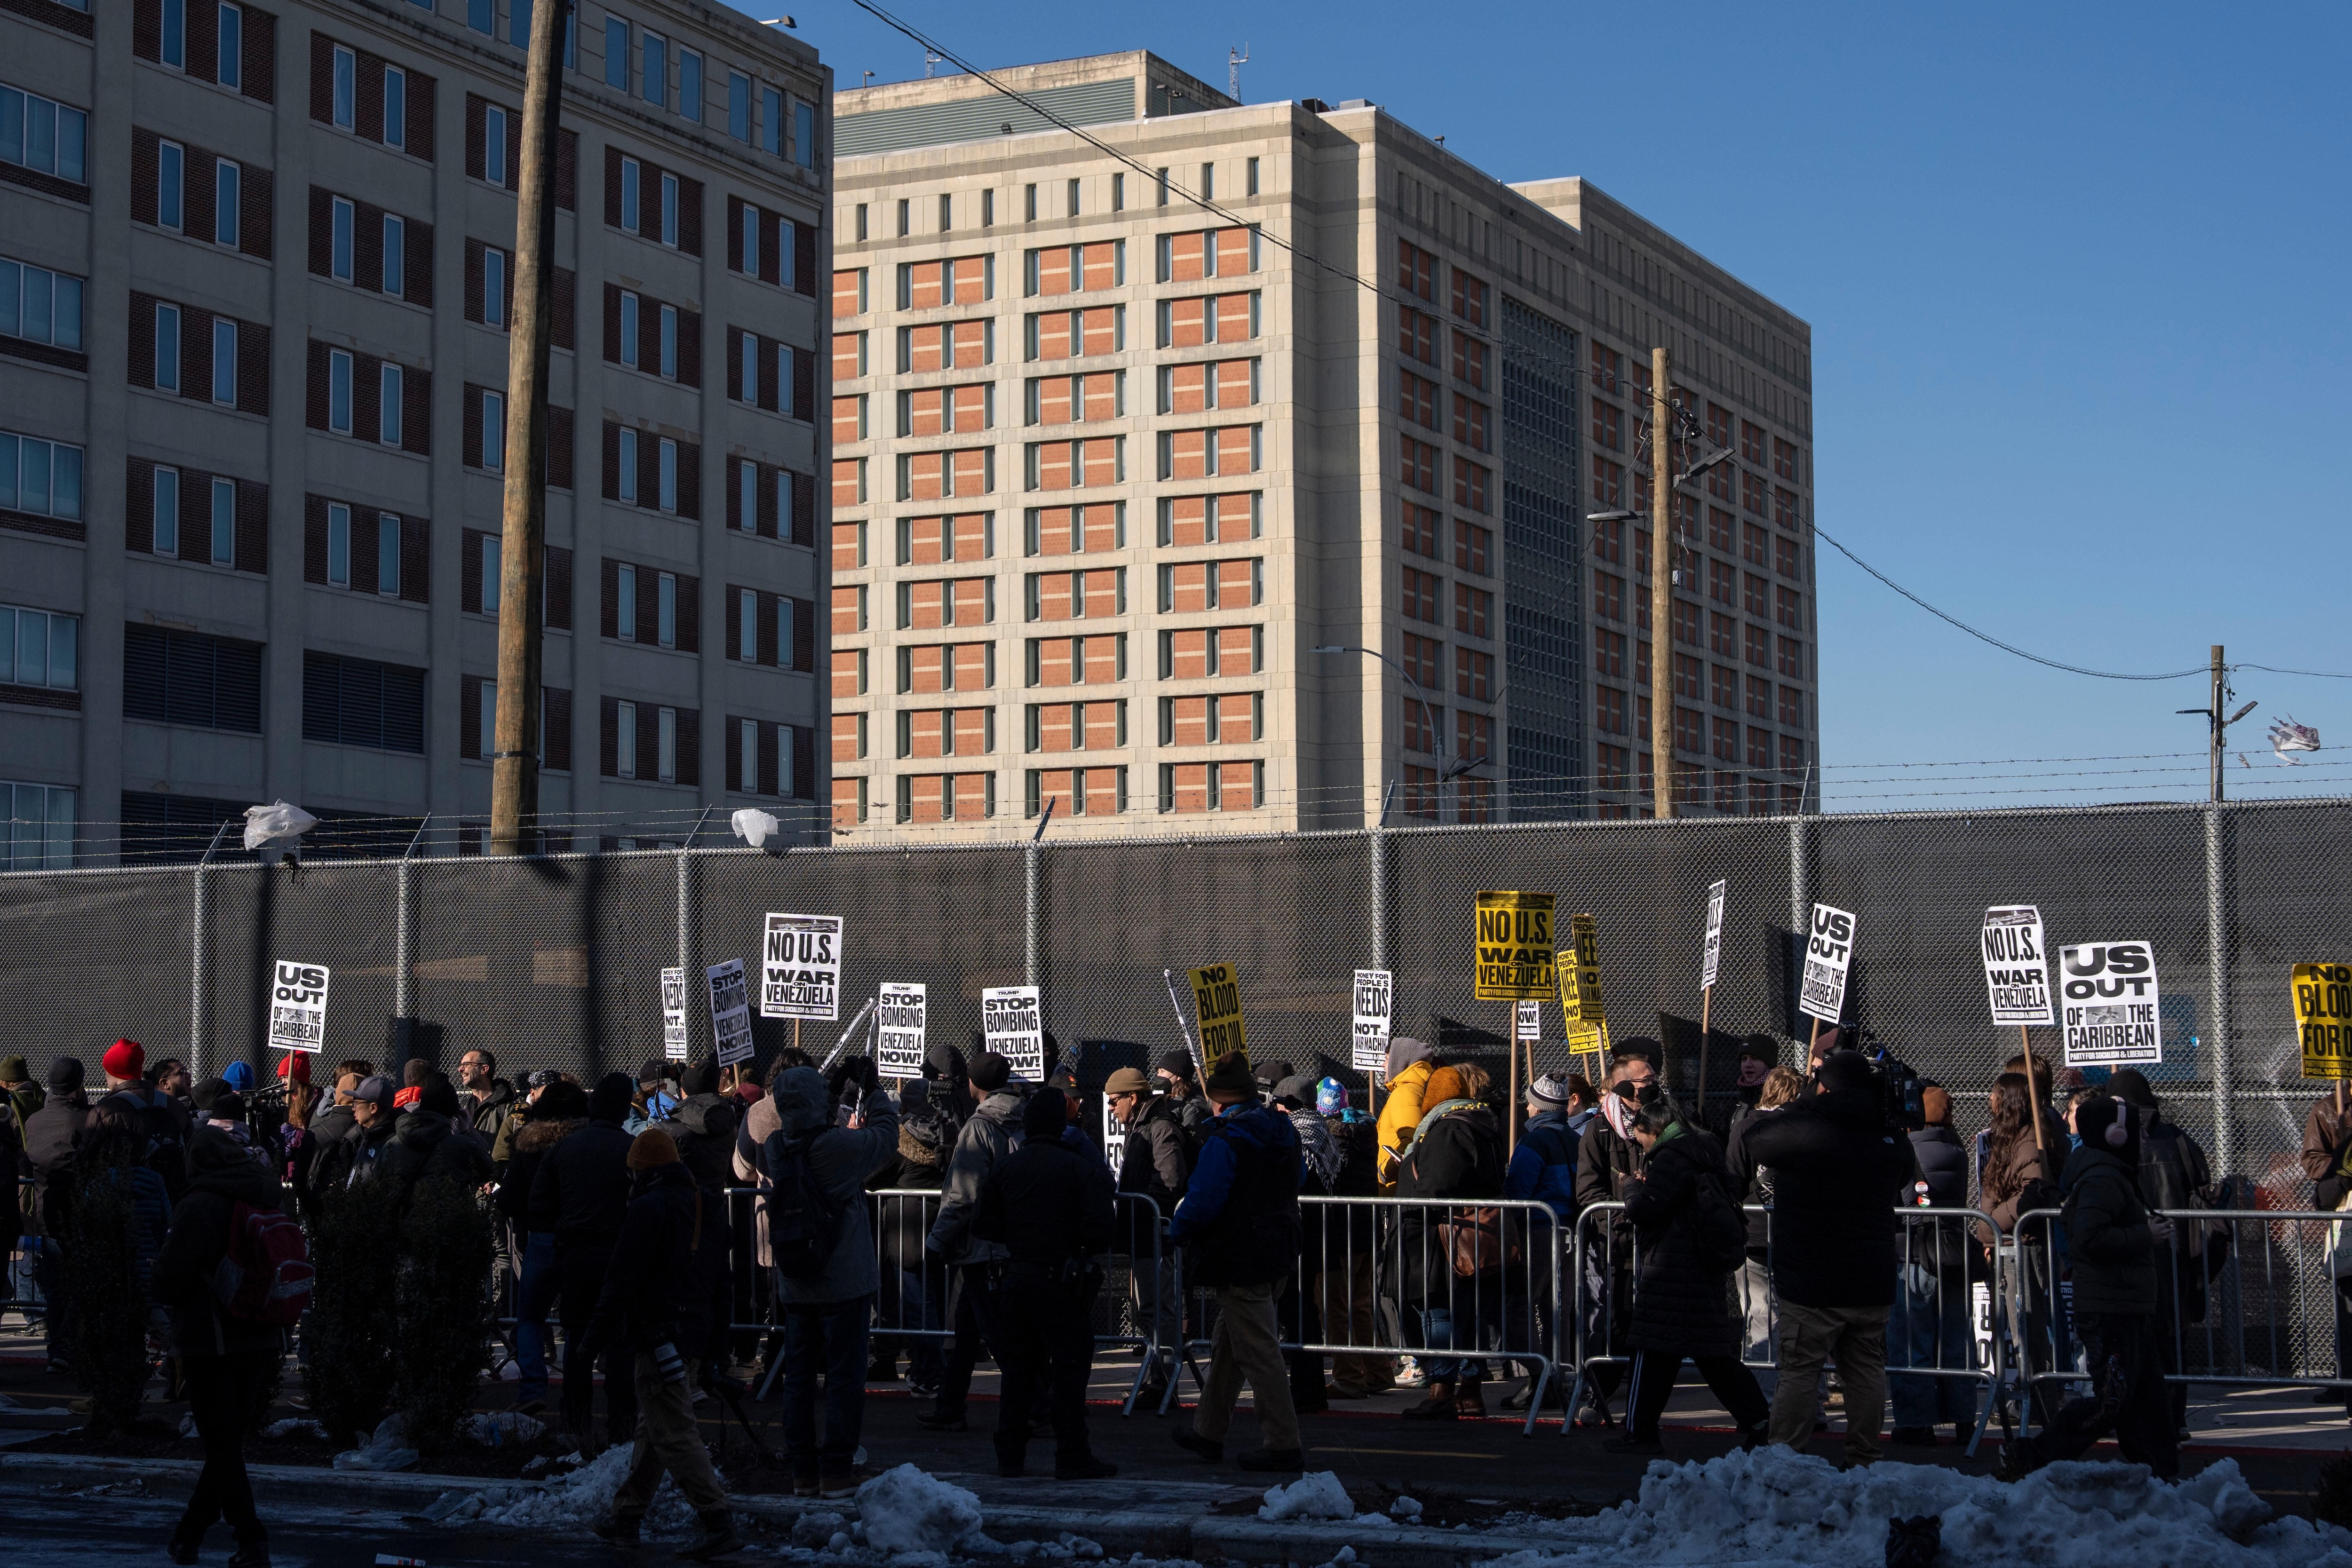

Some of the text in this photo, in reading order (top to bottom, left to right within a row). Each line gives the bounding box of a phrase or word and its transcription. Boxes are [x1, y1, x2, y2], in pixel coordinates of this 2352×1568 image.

[1479, 910, 1552, 944] NO U.S.
[1814, 908, 1851, 942] US
[768, 932, 836, 964] NO U.S.
[1574, 932, 1599, 967] NEE
[1810, 936, 1848, 962] OUT
[1984, 927, 2041, 961] NO U.S.
[1479, 947, 1551, 965] WAR
[2064, 945, 2149, 976] US
[278, 965, 325, 989] US
[712, 970, 743, 990] STOP
[767, 968, 835, 986] WAR
[1200, 966, 1227, 985] NO
[1479, 965, 1552, 987] VENEZUELA
[1806, 959, 1844, 987] OF THE
[1989, 969, 2043, 985] WAR
[2310, 966, 2351, 983] NO
[276, 987, 324, 1004] OUT
[766, 984, 834, 1006] VENEZUELA
[1561, 968, 1578, 1002] NEE
[1803, 977, 1841, 1008] CARIBBEAN
[2066, 977, 2152, 999] OUT
[714, 983, 746, 1014] BOMBING
[882, 993, 924, 1006] STOP
[985, 997, 1036, 1011] STOP
[1197, 982, 1239, 1022] BLOOD
[1356, 986, 1388, 1018] NEEDS
[1992, 987, 2047, 1008] VENEZUELA
[2297, 983, 2352, 1019] BLOO
[274, 1006, 321, 1024] OF THE
[666, 1015, 680, 1026] NOT
[715, 1012, 749, 1038] VENEZUELA
[881, 1006, 923, 1028] BOMBING
[985, 1011, 1038, 1033] BOMBING
[2066, 1004, 2154, 1026] OF THE
[273, 1020, 320, 1040] CARIBBEAN
[1202, 1020, 1246, 1058] FOR OIL
[1355, 1023, 1381, 1035] NOT
[2068, 1024, 2155, 1049] CARIBBEAN
[2303, 1024, 2341, 1056] FOR
[718, 1030, 751, 1052] NOW!
[881, 1032, 922, 1051] VENEZUELA
[988, 1037, 1040, 1055] VENEZUELA
[1355, 1036, 1387, 1052] WAR MACHIN
[880, 1051, 922, 1064] NOW!
[1005, 1056, 1040, 1068] OW!
